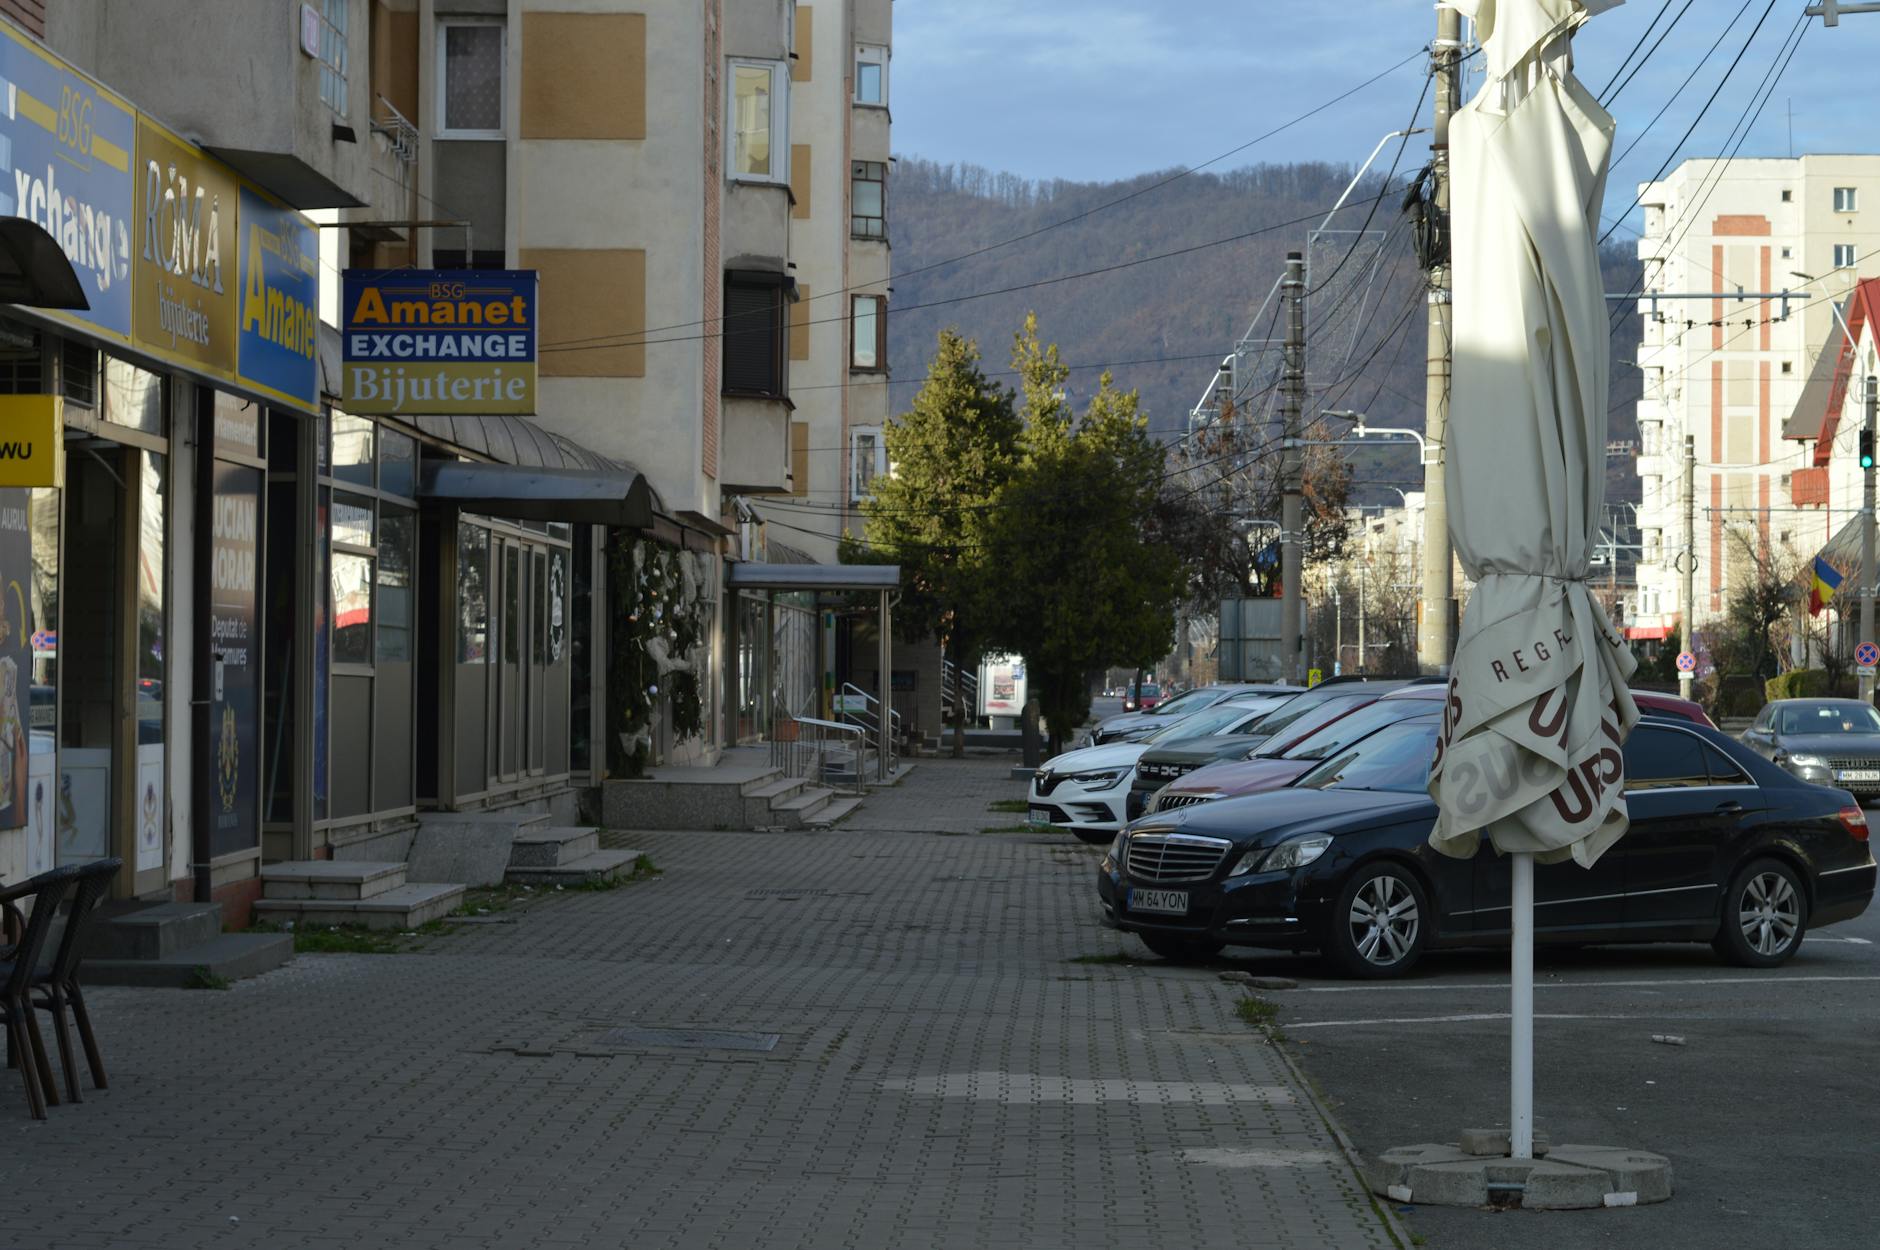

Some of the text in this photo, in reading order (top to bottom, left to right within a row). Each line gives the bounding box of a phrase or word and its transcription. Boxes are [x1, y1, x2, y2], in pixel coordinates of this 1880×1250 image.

[58, 84, 93, 155] BSG
[352, 287, 527, 324] Amanet
[431, 283, 464, 298] BSG
[158, 280, 209, 349] bijuterie
[351, 334, 527, 357] EXCHANGE
[351, 367, 526, 411] Bijuterie
[1, 507, 28, 532] AURUL
[213, 496, 255, 542] UCIAN
[1147, 892, 1159, 907] 64
[1161, 892, 1187, 910] YON
